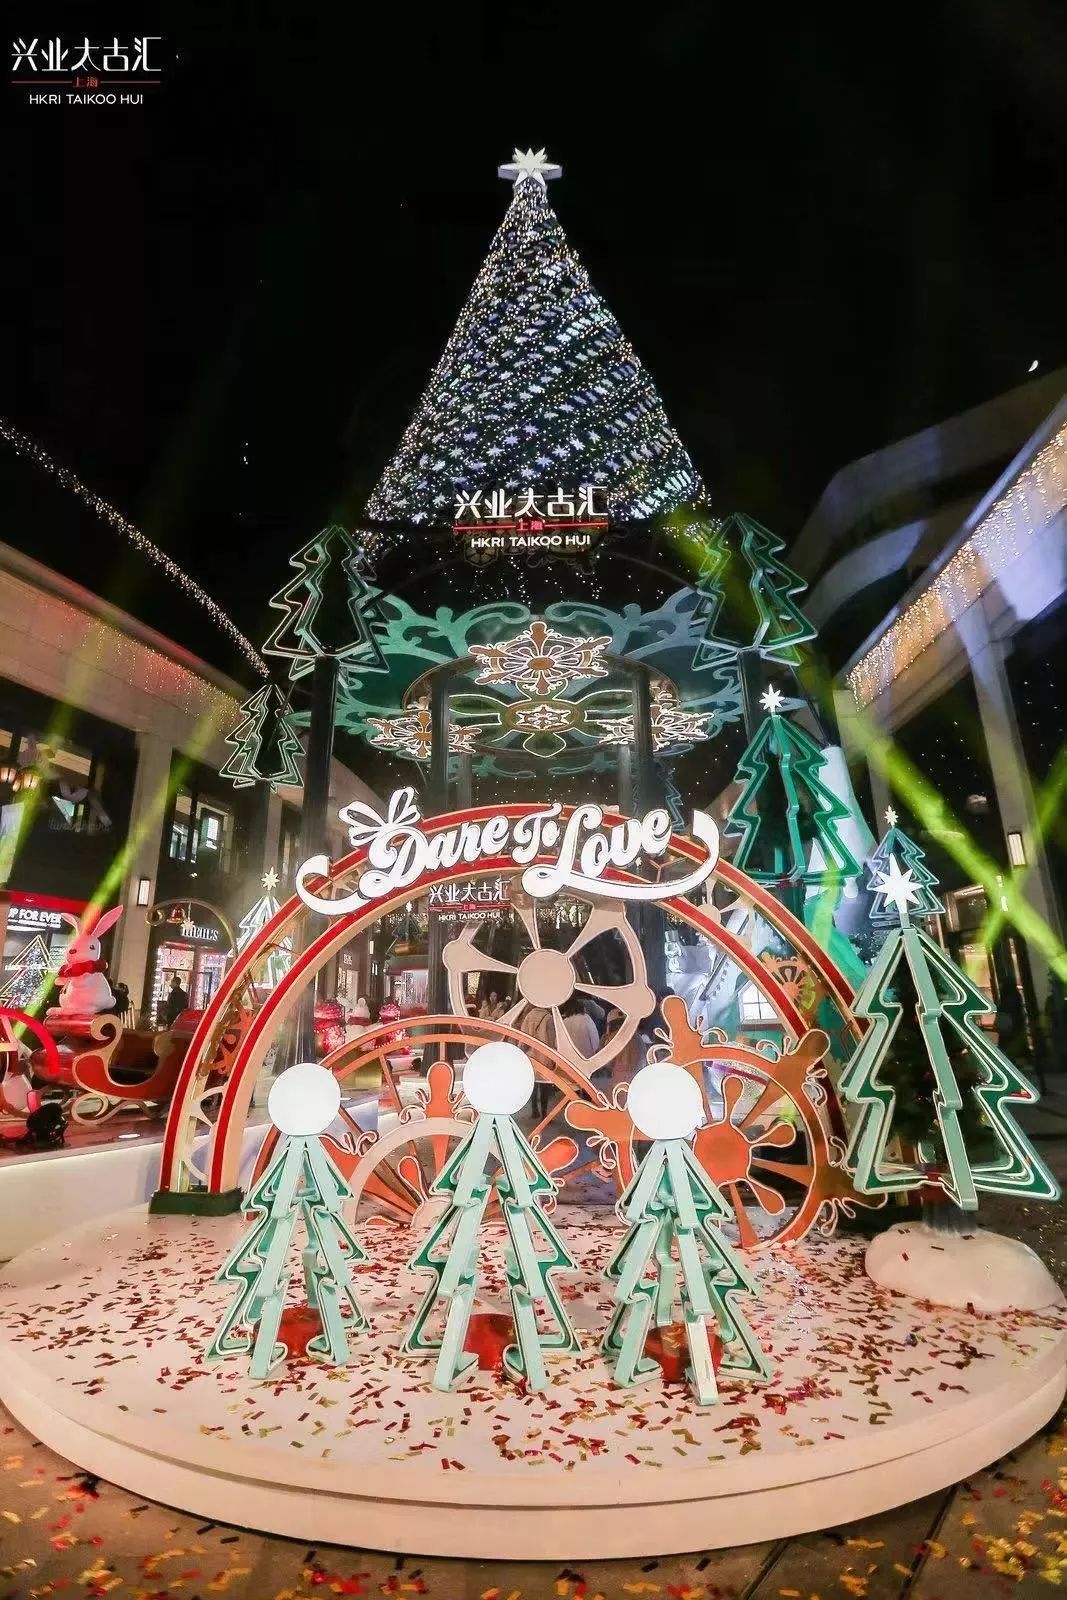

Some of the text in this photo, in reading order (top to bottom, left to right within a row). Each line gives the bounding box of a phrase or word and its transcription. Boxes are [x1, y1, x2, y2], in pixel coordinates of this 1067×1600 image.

[453, 486, 609, 519] 兴业太古汇
[470, 535, 591, 548] HKRI TAIKOO HUI
[330, 788, 720, 903] Dare To Love
[429, 880, 511, 903] 兴业太古汇
[19, 909, 39, 921] FOR
[458, 912, 486, 920] TAIKOO
